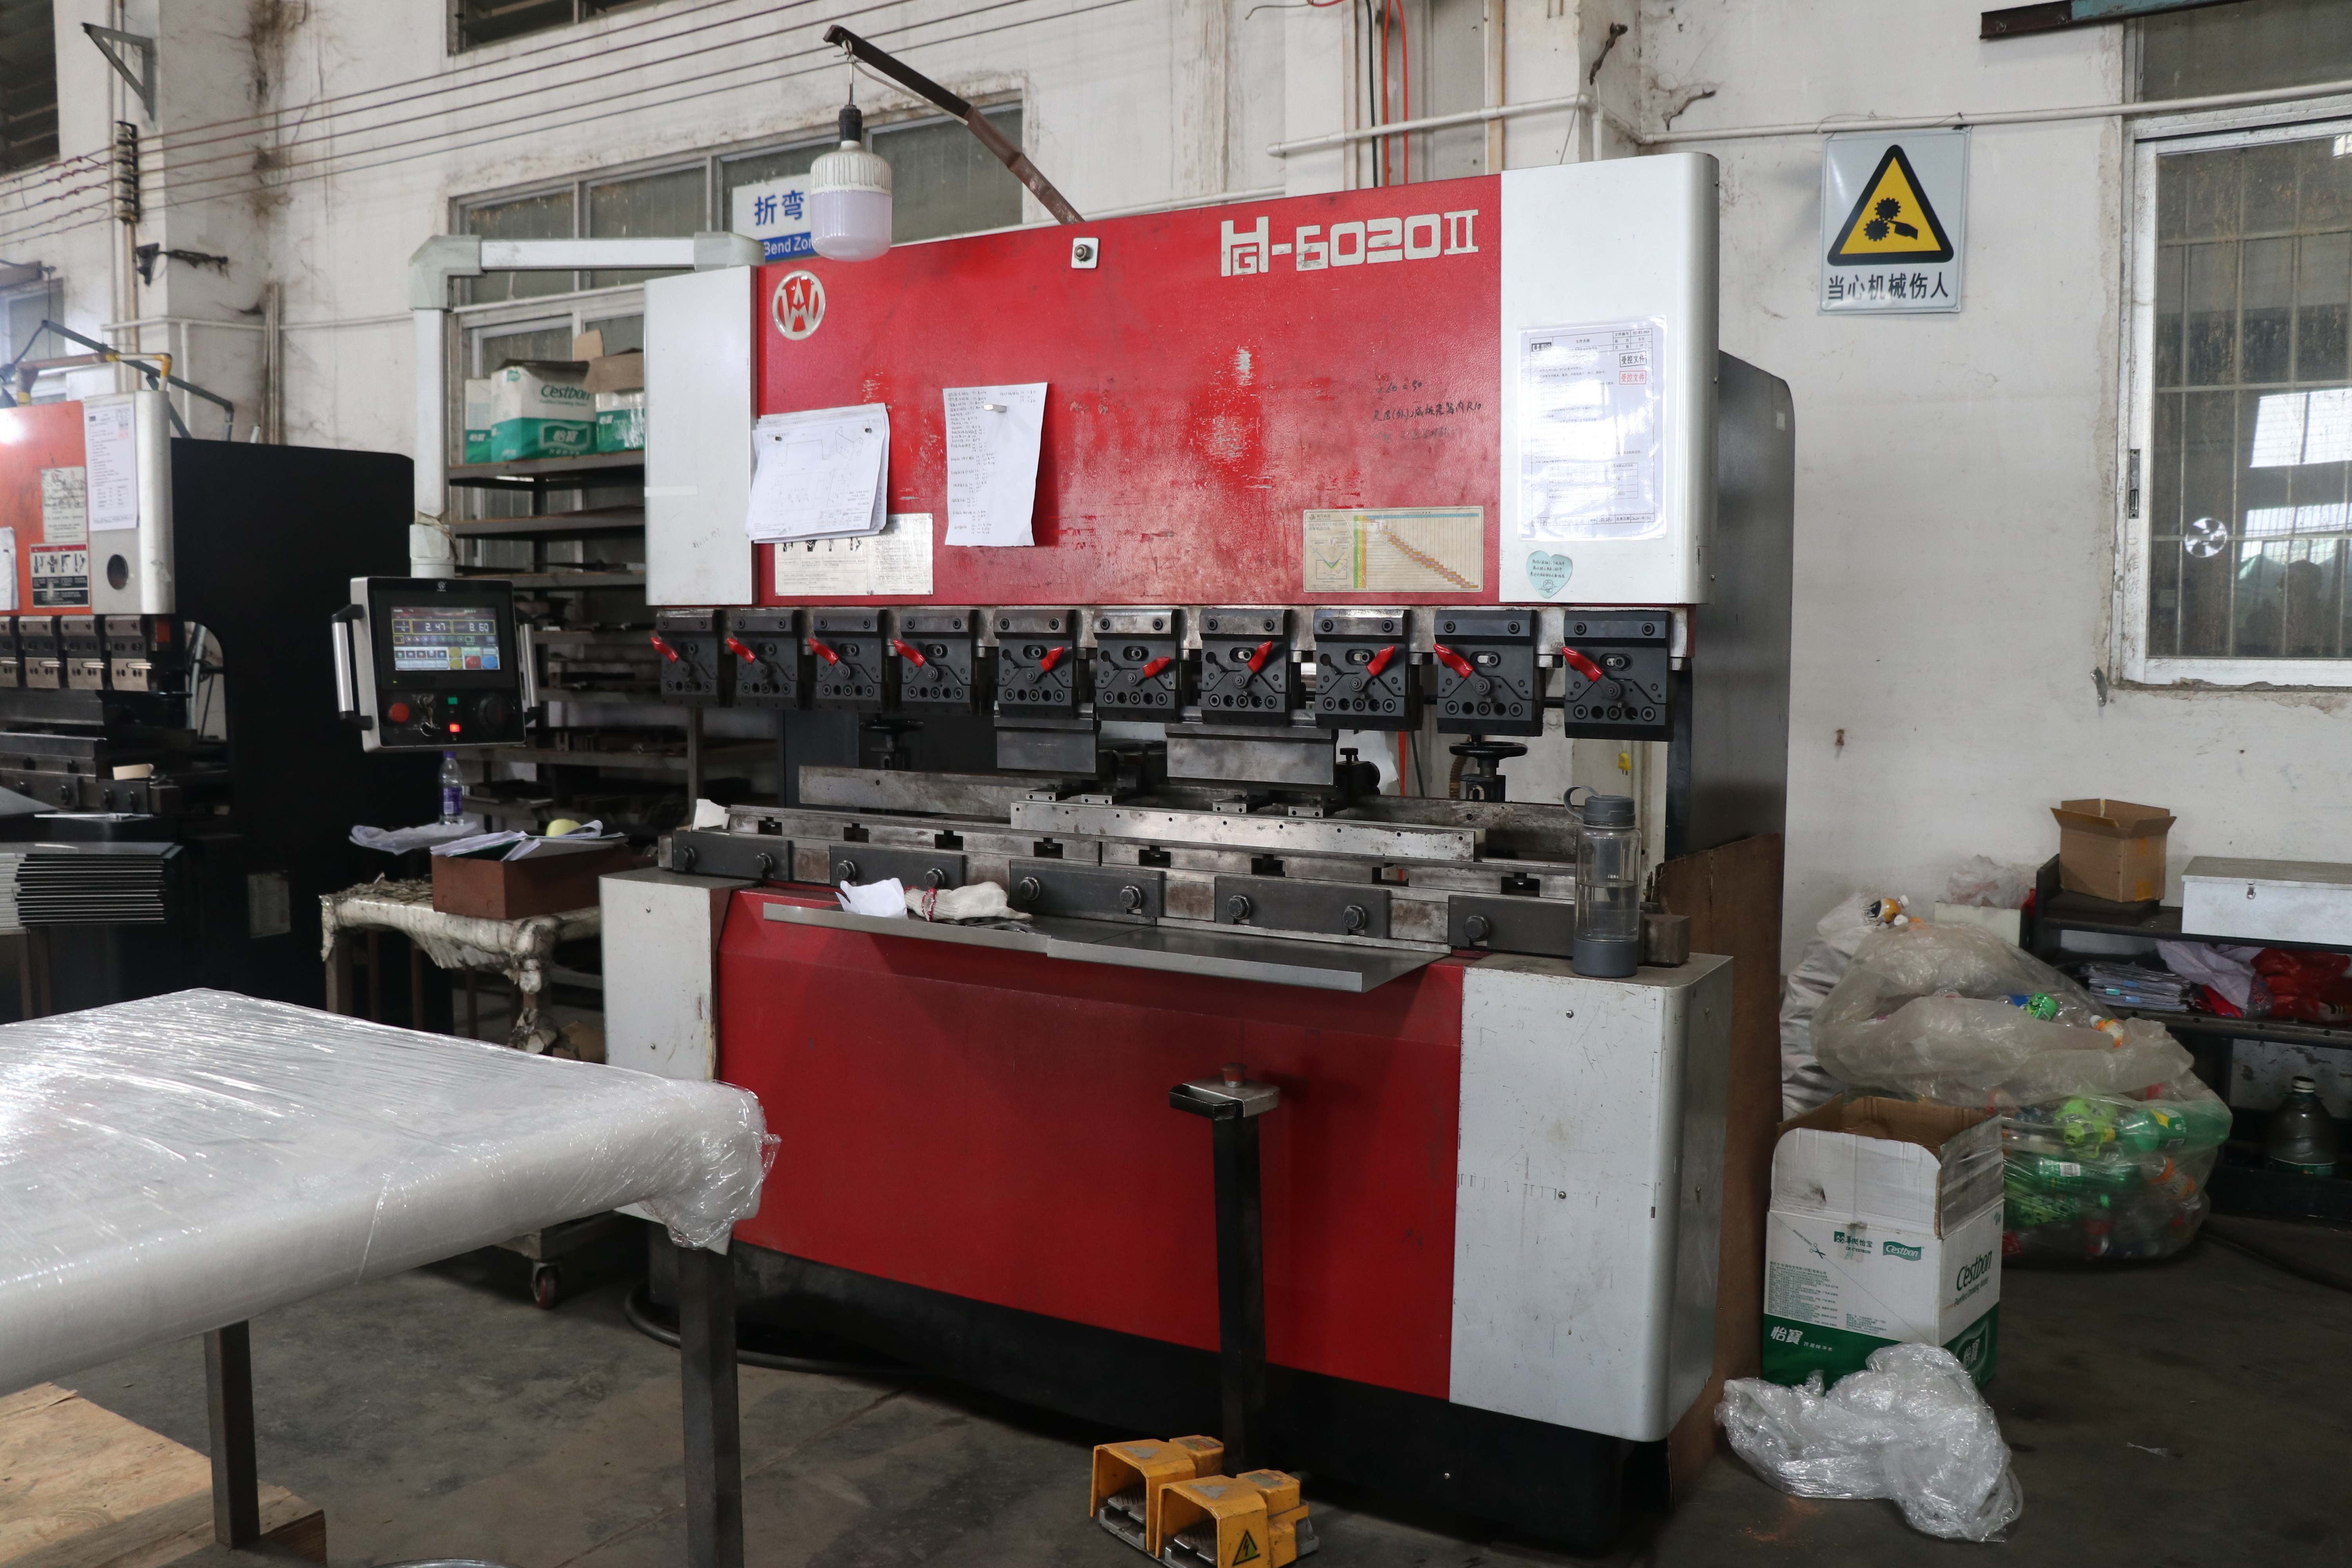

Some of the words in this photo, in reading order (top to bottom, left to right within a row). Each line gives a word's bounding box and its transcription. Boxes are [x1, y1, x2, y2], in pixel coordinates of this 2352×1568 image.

[754, 190, 805, 226] 折弯
[764, 238, 791, 256] Bend
[1828, 271, 1949, 301] 当心机械伤人
[1621, 353, 1646, 365] 受控文件
[1621, 373, 1645, 383] 受控文件
